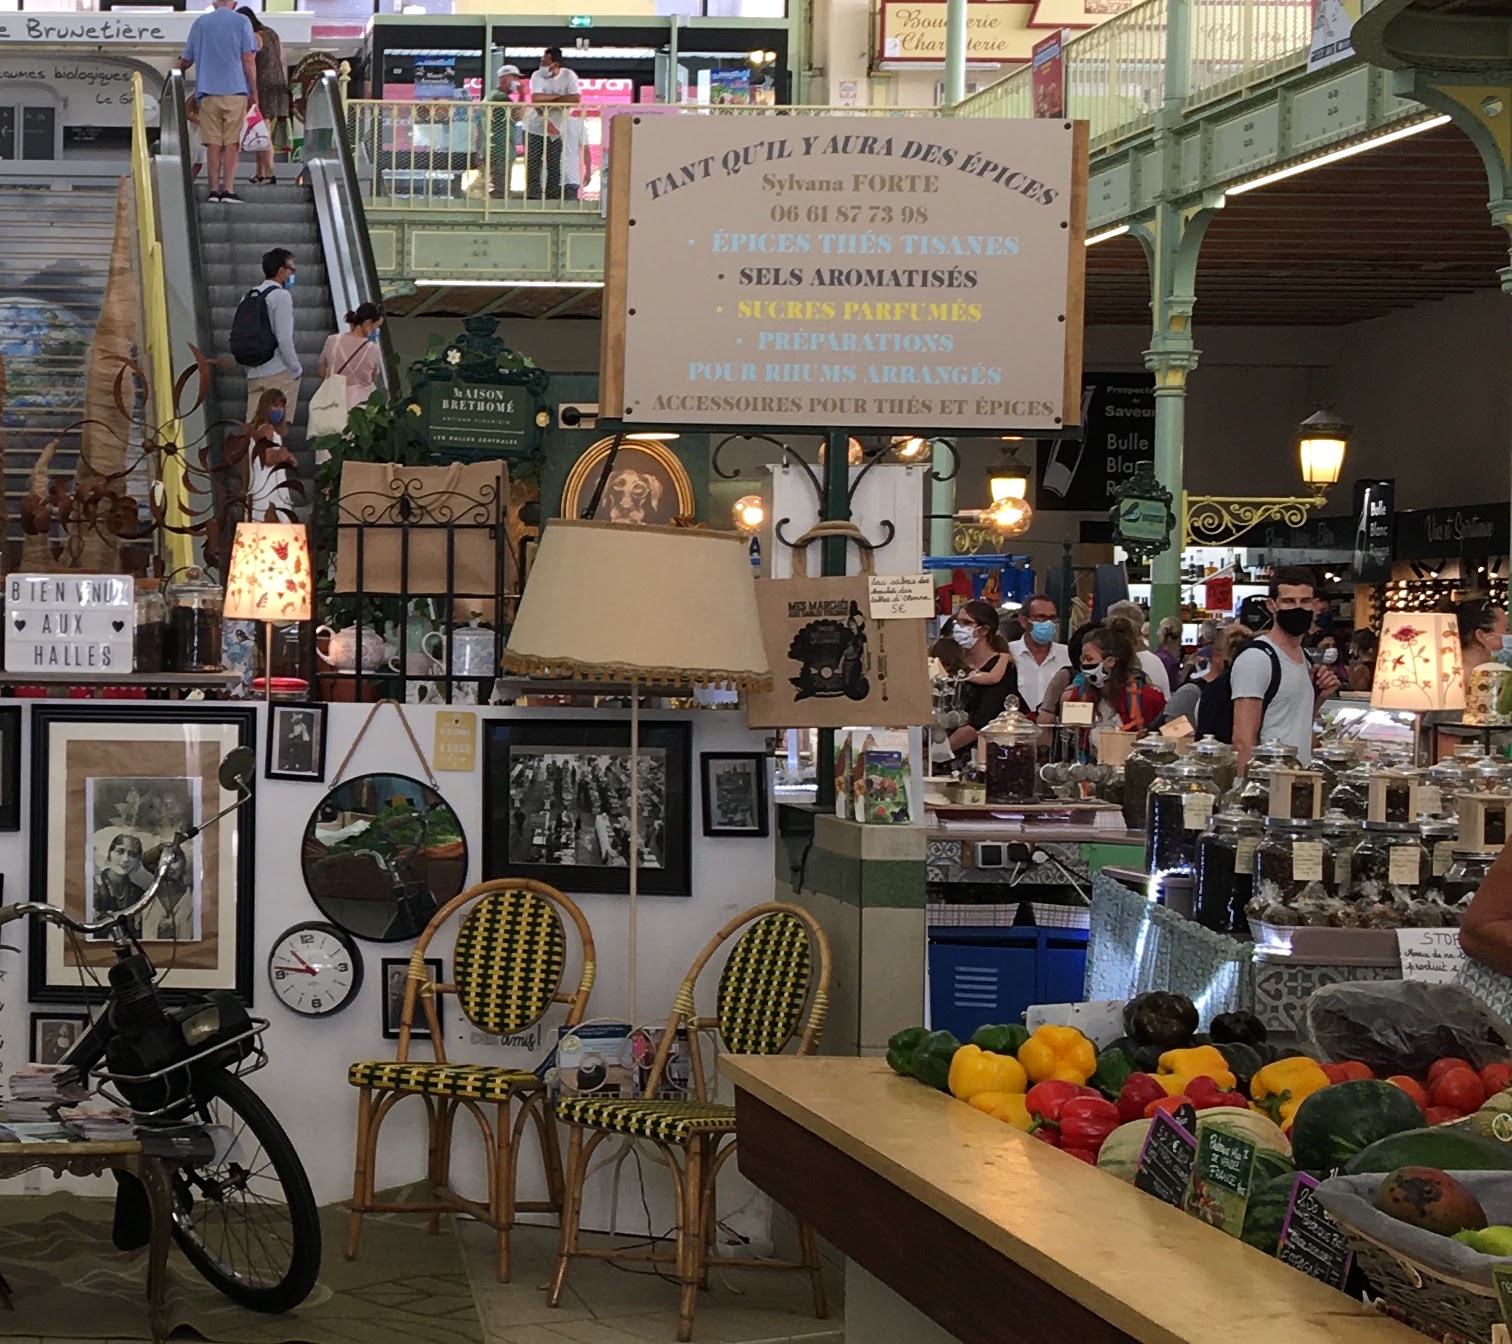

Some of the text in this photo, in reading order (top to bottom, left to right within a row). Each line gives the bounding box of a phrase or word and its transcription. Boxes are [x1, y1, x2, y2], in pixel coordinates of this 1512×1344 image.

[54, 65, 133, 86] biologiques
[644, 156, 716, 202] TANT
[801, 135, 822, 156] Y
[821, 134, 894, 157] AURA
[899, 139, 955, 168] DES
[958, 150, 1059, 207] ÉPICES
[761, 173, 940, 196] Sylvana FORTE
[770, 205, 929, 225] 06 61 87 73 98
[712, 229, 1020, 257] ÉPICES THÉS TISANES
[738, 265, 978, 288] SELS AROMATISÉS
[737, 299, 983, 323] SUCRES PARFUMÉS
[757, 329, 955, 353] PRÉPARATIONS
[688, 360, 1002, 385] POUR RHUMS ARRANGÉS
[453, 387, 505, 400] MAISON
[441, 399, 515, 414] BRETHOMÉ
[651, 393, 1055, 417] ACCESSOIRES POUR THÉS ET ÉPICES
[1107, 433, 1149, 450] Bulle
[1370, 500, 1387, 516] Bulle
[787, 600, 807, 611] MES
[890, 603, 907, 614] 5€
[41, 613, 83, 634] AUX
[33, 645, 112, 667] HALLES
[299, 934, 315, 944] 12
[337, 962, 349, 973] 3
[1405, 961, 1448, 976] produit
